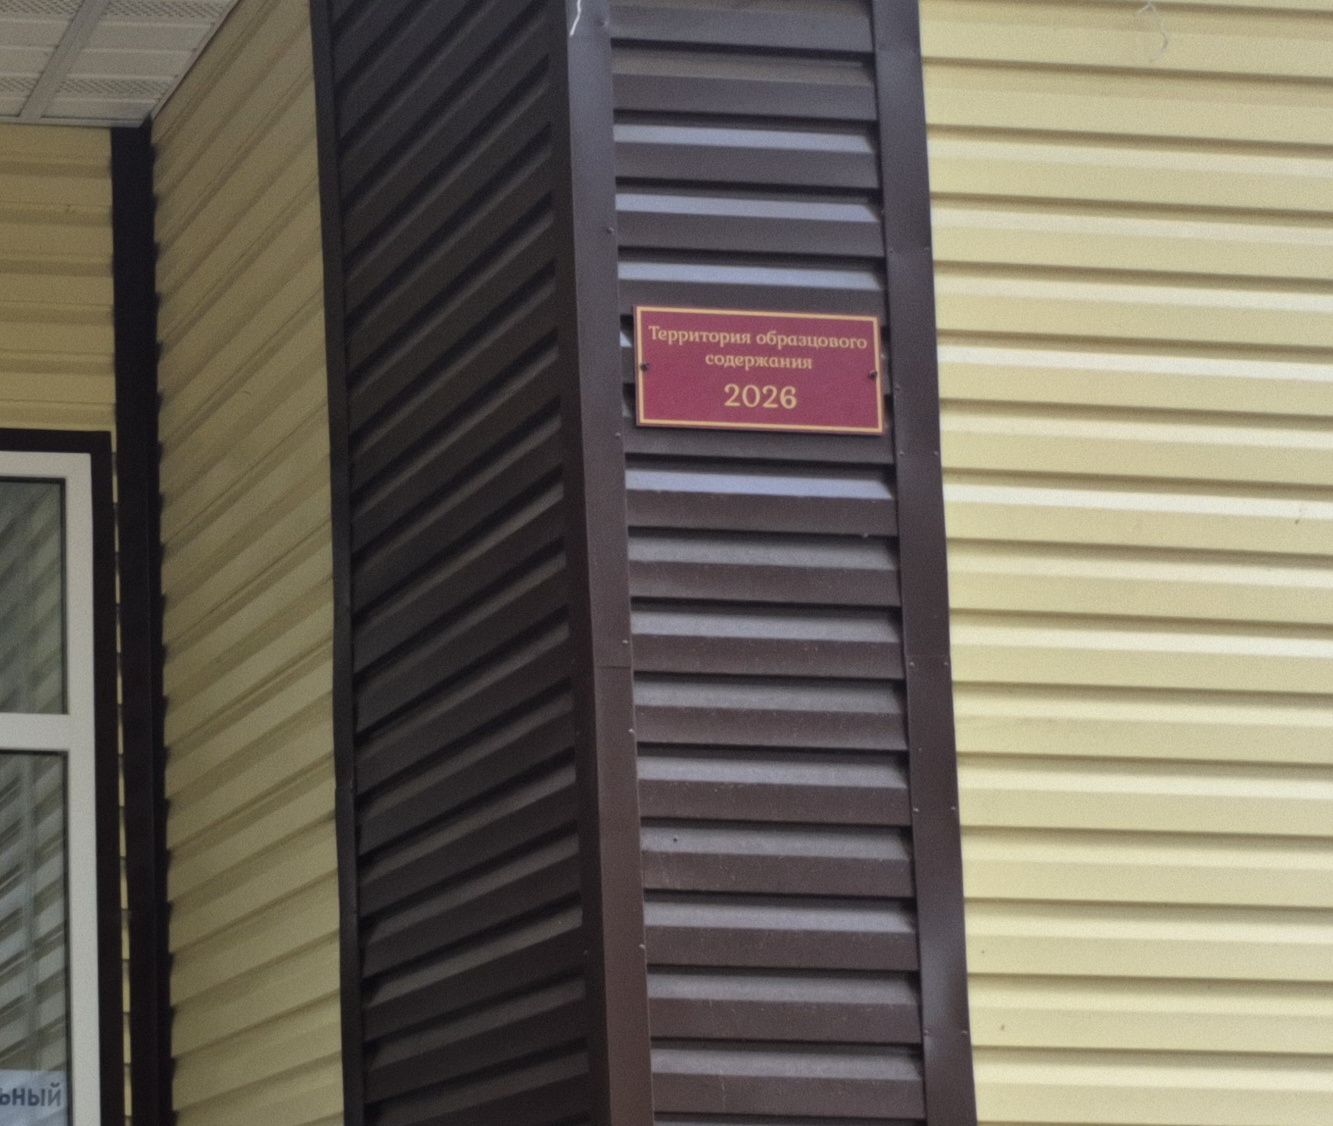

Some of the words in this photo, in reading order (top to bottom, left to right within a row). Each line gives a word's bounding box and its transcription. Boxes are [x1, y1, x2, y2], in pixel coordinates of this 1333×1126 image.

[648, 326, 751, 347] Территория
[756, 330, 868, 350] образцового
[705, 354, 813, 371] содержания
[724, 383, 798, 409] 2026
